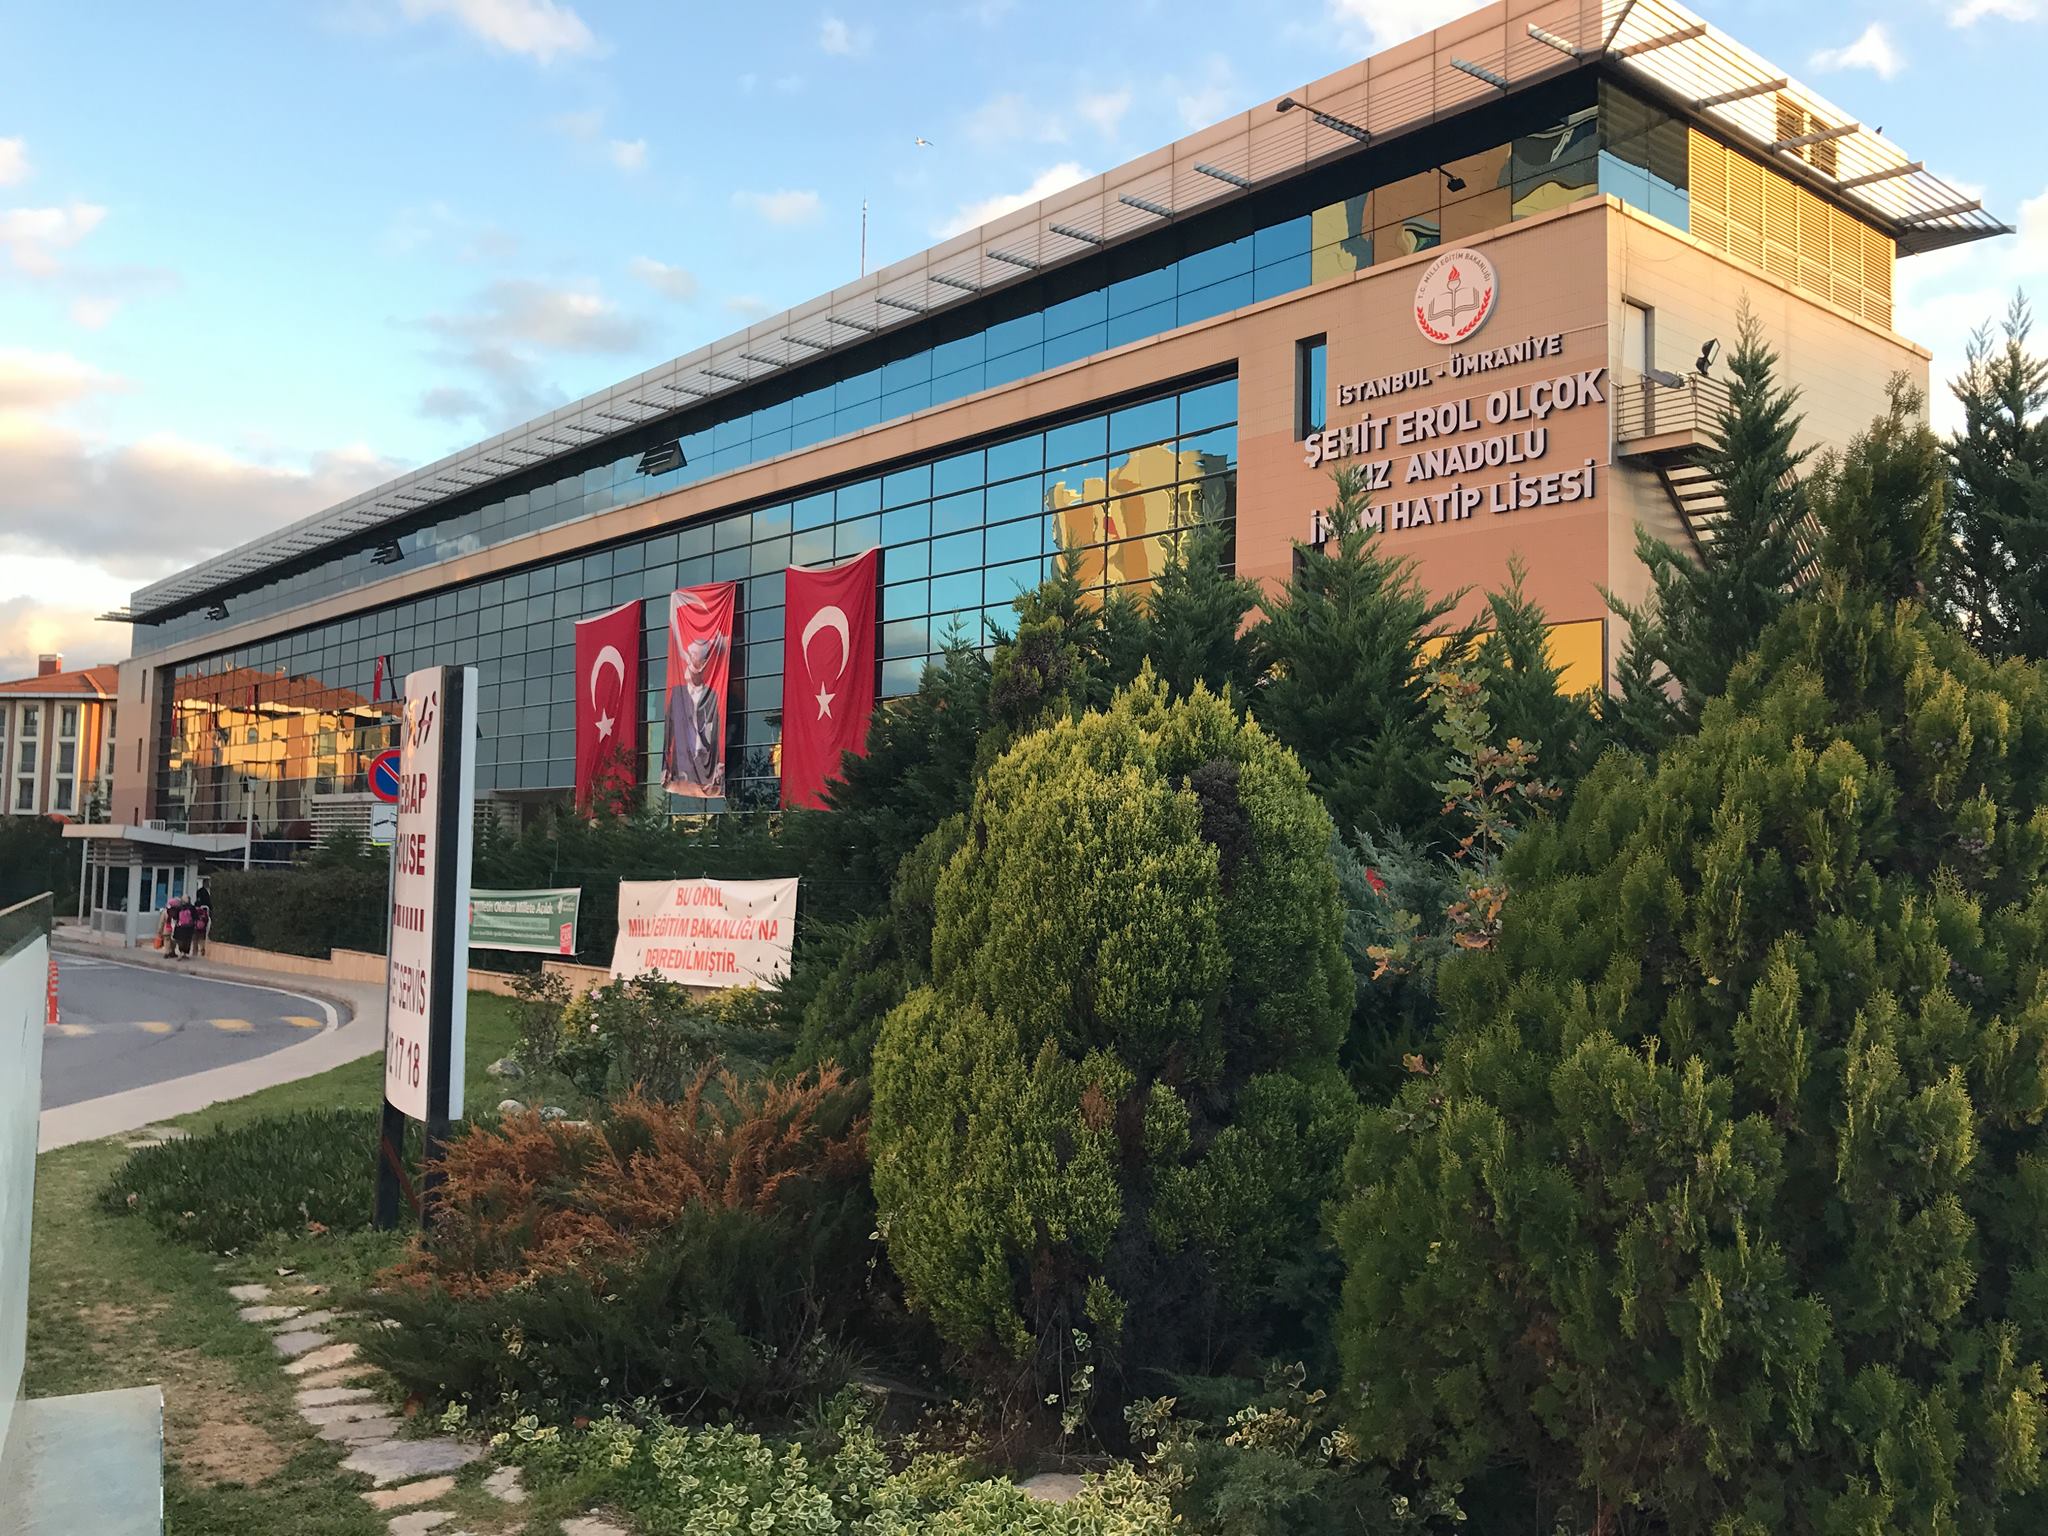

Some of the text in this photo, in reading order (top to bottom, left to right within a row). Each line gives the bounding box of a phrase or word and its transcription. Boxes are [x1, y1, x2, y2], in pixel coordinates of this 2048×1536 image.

[1336, 366, 1431, 406] İSTANBUL
[1450, 334, 1562, 378] ÜMRANİYE
[1304, 367, 1605, 469] ŞEHİT EROL OLÇOK
[1405, 428, 1547, 484] ANADOLU
[1391, 483, 1483, 531] HATİP
[1490, 458, 1595, 514] LİSESİ
[399, 773, 428, 814] EBAP
[675, 886, 724, 907] BU OKUL
[628, 914, 654, 938] MİLLİ
[654, 913, 689, 939] EĞİTİM
